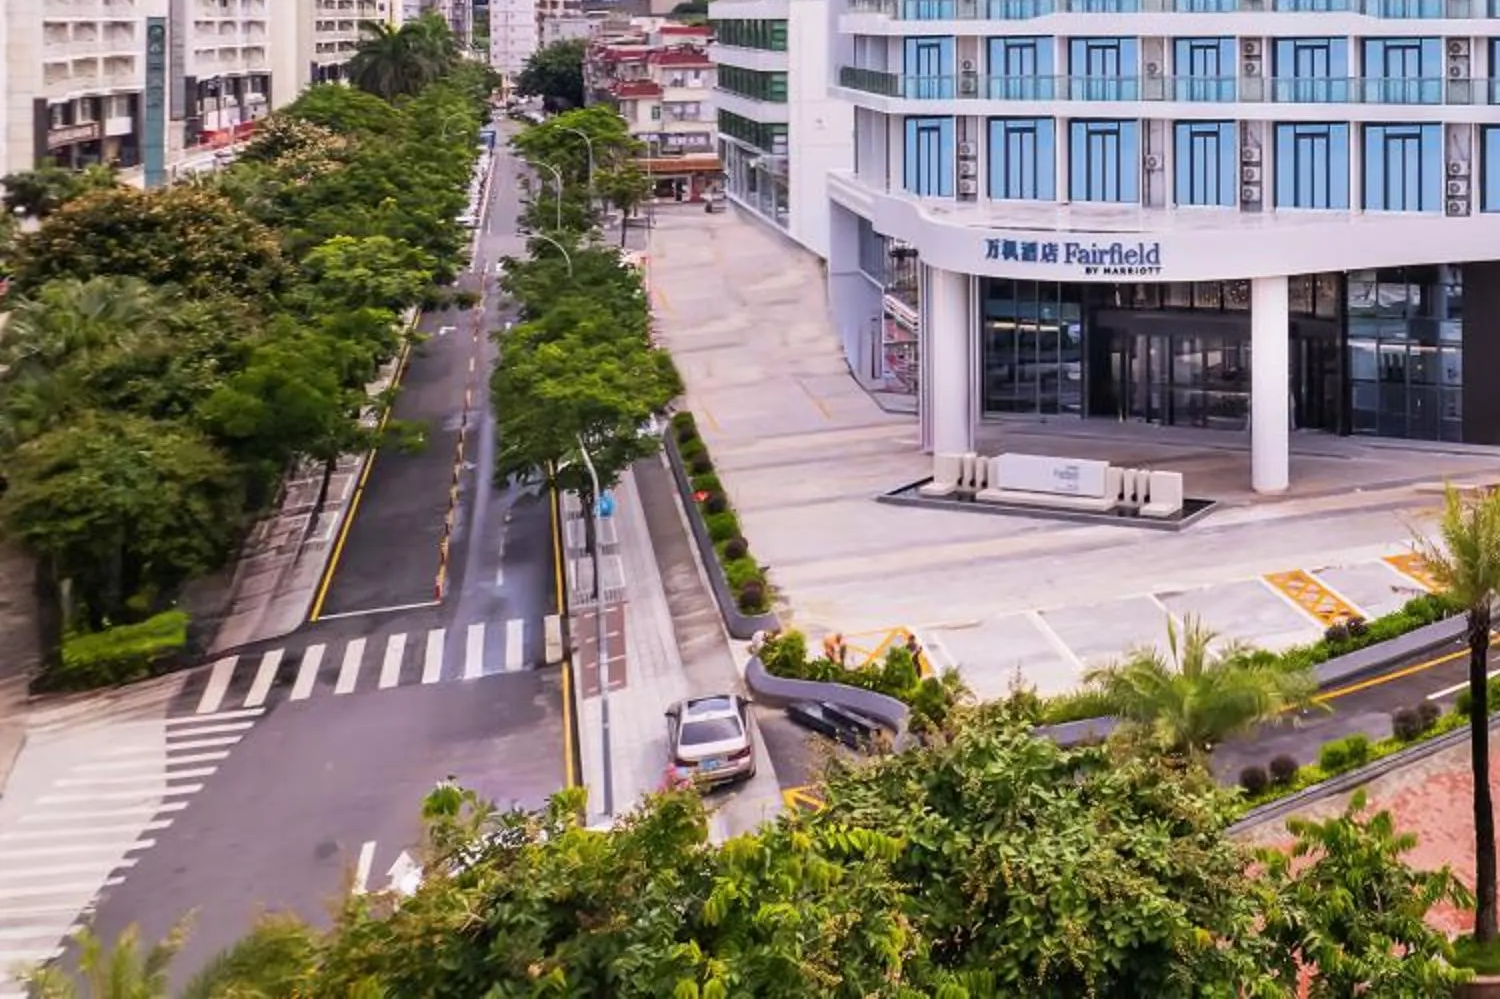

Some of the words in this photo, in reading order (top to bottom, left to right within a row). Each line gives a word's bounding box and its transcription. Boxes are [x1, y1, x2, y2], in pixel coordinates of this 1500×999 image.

[985, 238, 1059, 264] 万枫酒店
[1064, 242, 1161, 266] Fairfield
[1085, 266, 1099, 275] BY
[1103, 266, 1162, 275] MARRIOTT
